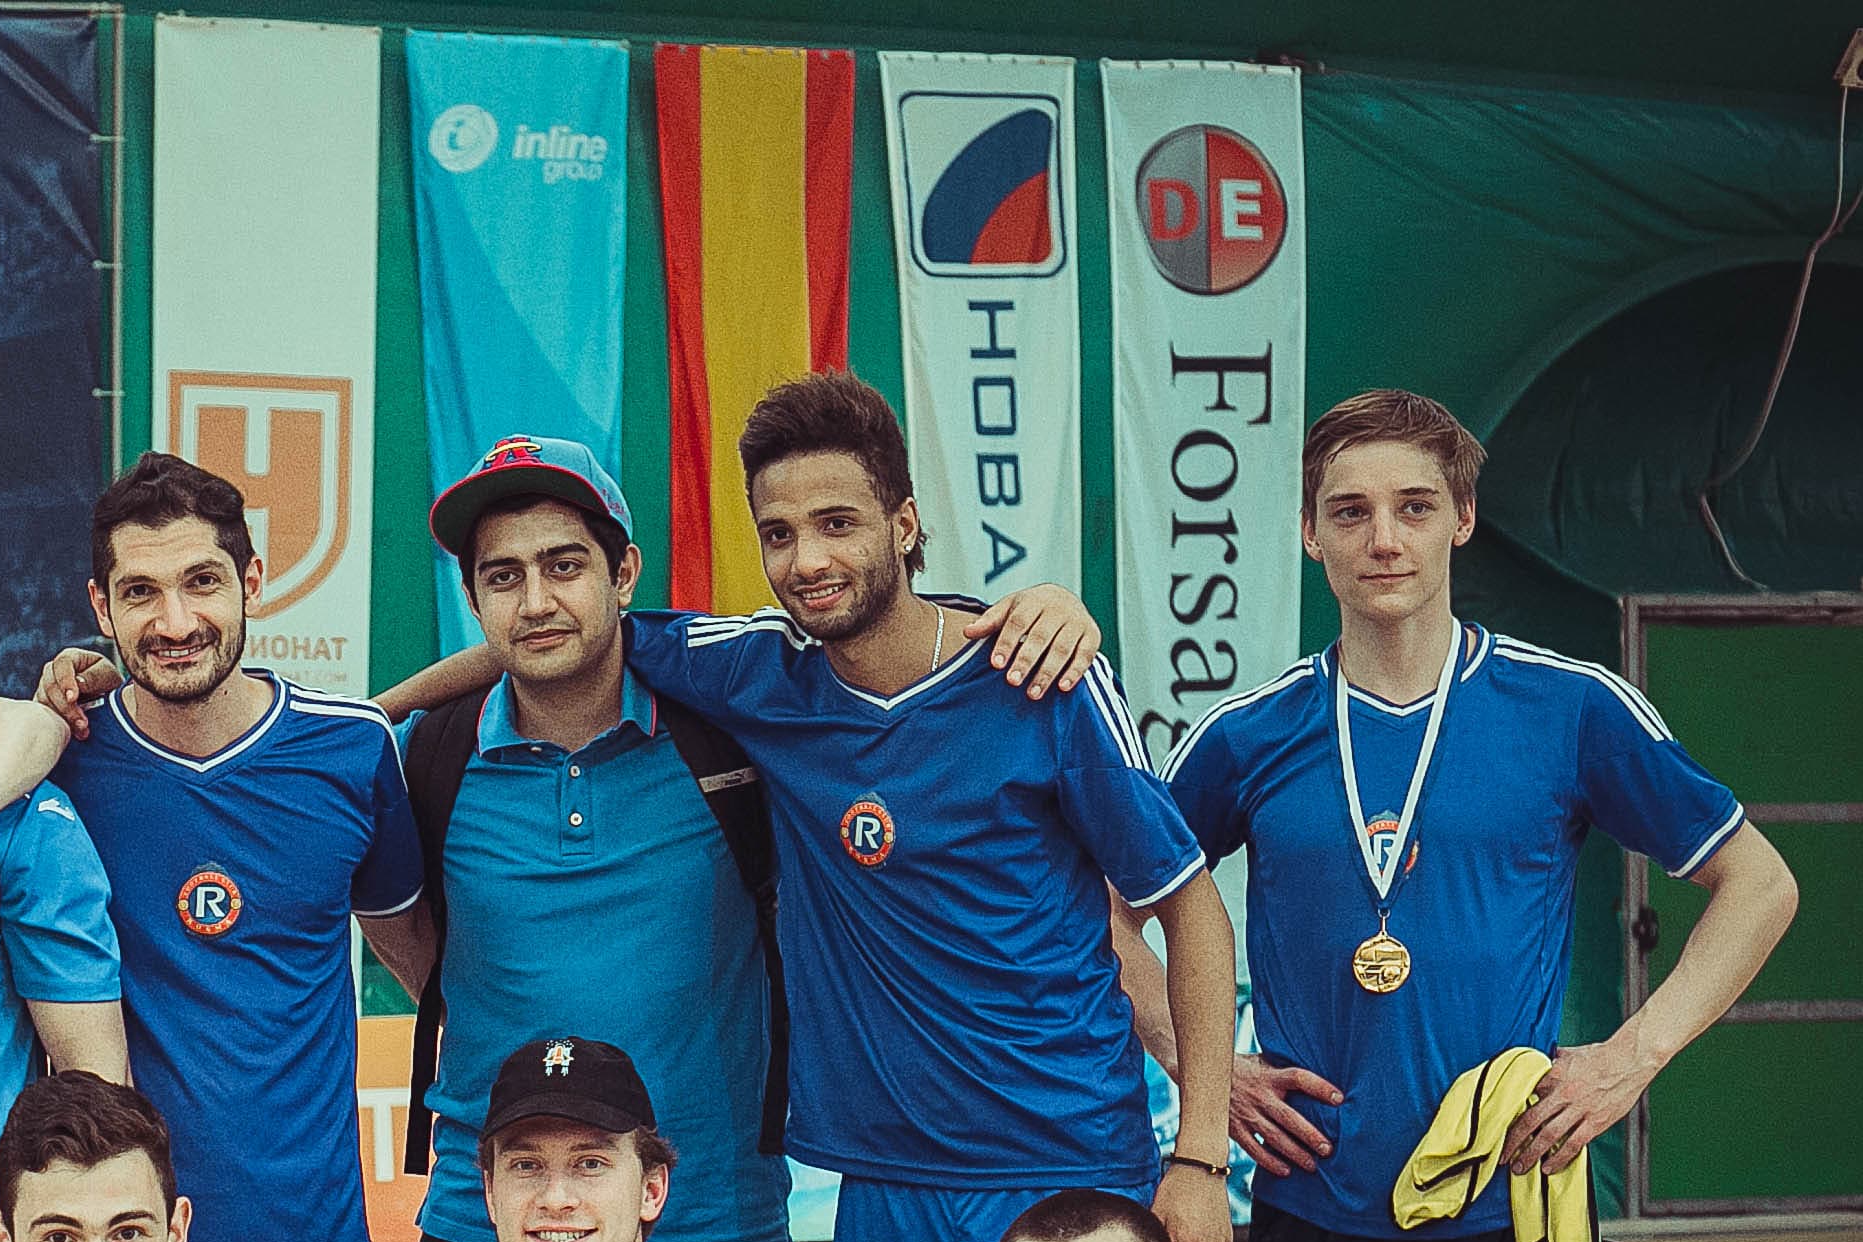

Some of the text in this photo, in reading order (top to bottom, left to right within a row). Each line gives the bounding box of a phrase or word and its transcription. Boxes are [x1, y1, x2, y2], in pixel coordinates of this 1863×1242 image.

[512, 124, 608, 162] inline
[1147, 178, 1263, 241] DE
[247, 634, 348, 661] ИОНАТ
[854, 815, 880, 850] R
[196, 886, 226, 918] R
